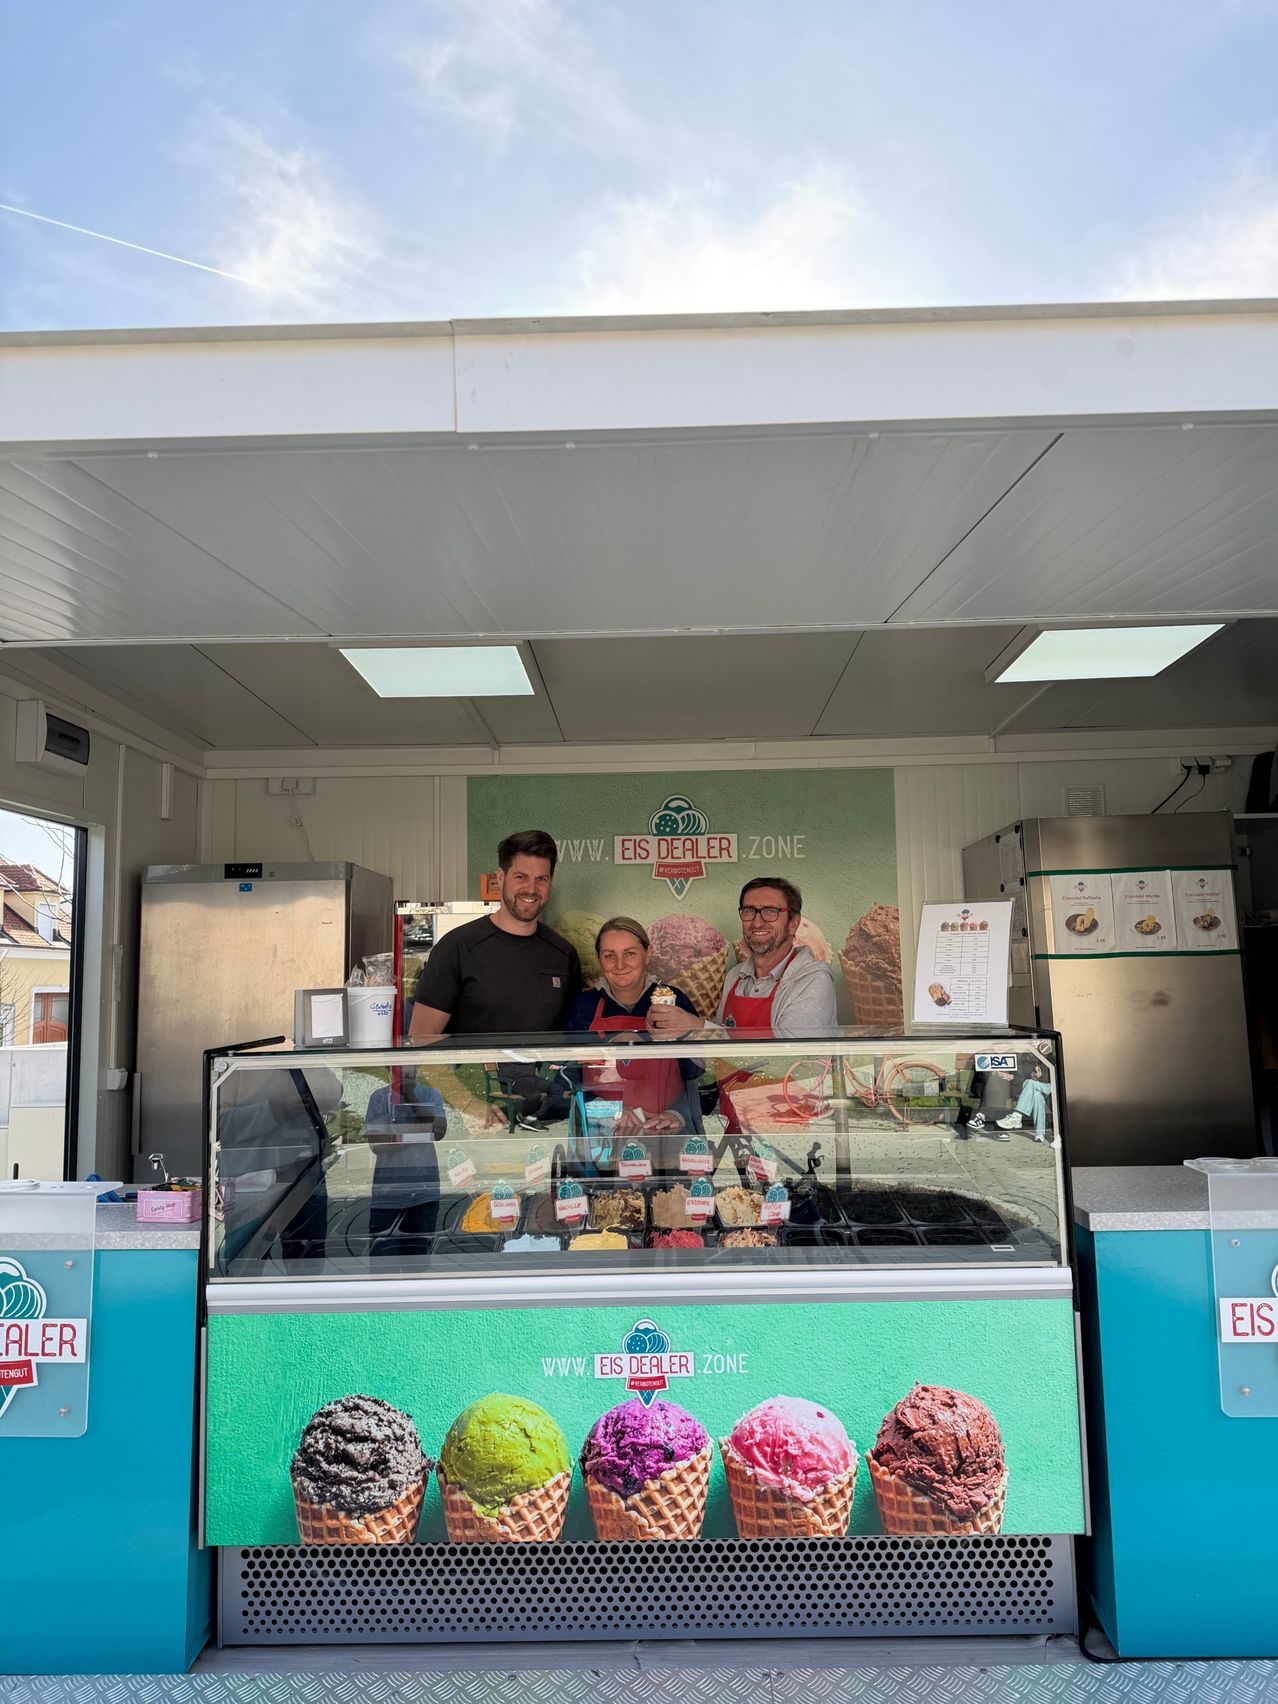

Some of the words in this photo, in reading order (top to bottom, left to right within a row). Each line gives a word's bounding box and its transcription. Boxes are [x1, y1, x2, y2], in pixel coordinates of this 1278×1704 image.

[621, 838, 650, 861] EIS
[657, 836, 733, 860] DEALER
[741, 835, 806, 859] .ZONE
[990, 1056, 1008, 1066] ISA
[1231, 1302, 1275, 1337] EIS
[0, 1323, 77, 1357] ALER
[0, 1367, 28, 1379] TENGUT
[541, 1356, 590, 1377] WWW.
[600, 1356, 623, 1376] EIS
[629, 1354, 690, 1375] DEALER
[697, 1353, 749, 1374] .ZONE
